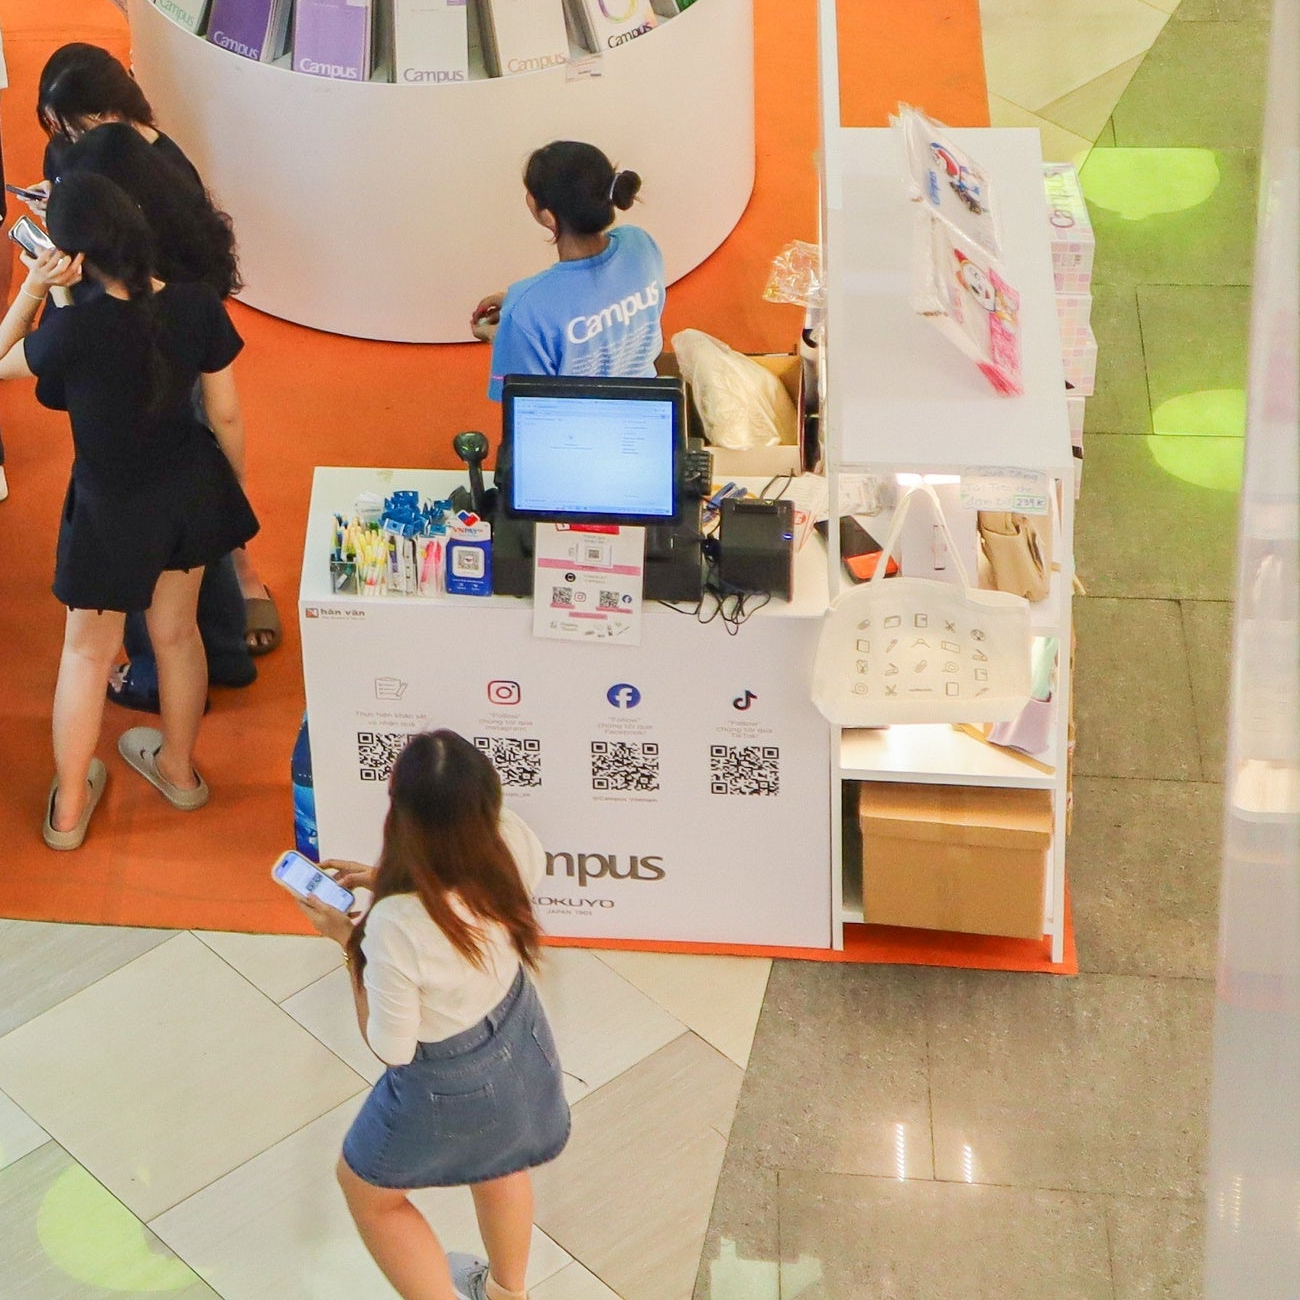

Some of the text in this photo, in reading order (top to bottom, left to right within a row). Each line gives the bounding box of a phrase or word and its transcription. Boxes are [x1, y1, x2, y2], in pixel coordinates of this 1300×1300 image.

[213, 30, 260, 60] Campus
[607, 20, 653, 49] Campus
[300, 58, 359, 80] Campus
[403, 66, 464, 84] Campus
[507, 53, 566, 74] Campus
[567, 279, 660, 345] Campus
[546, 850, 667, 888] mpus
